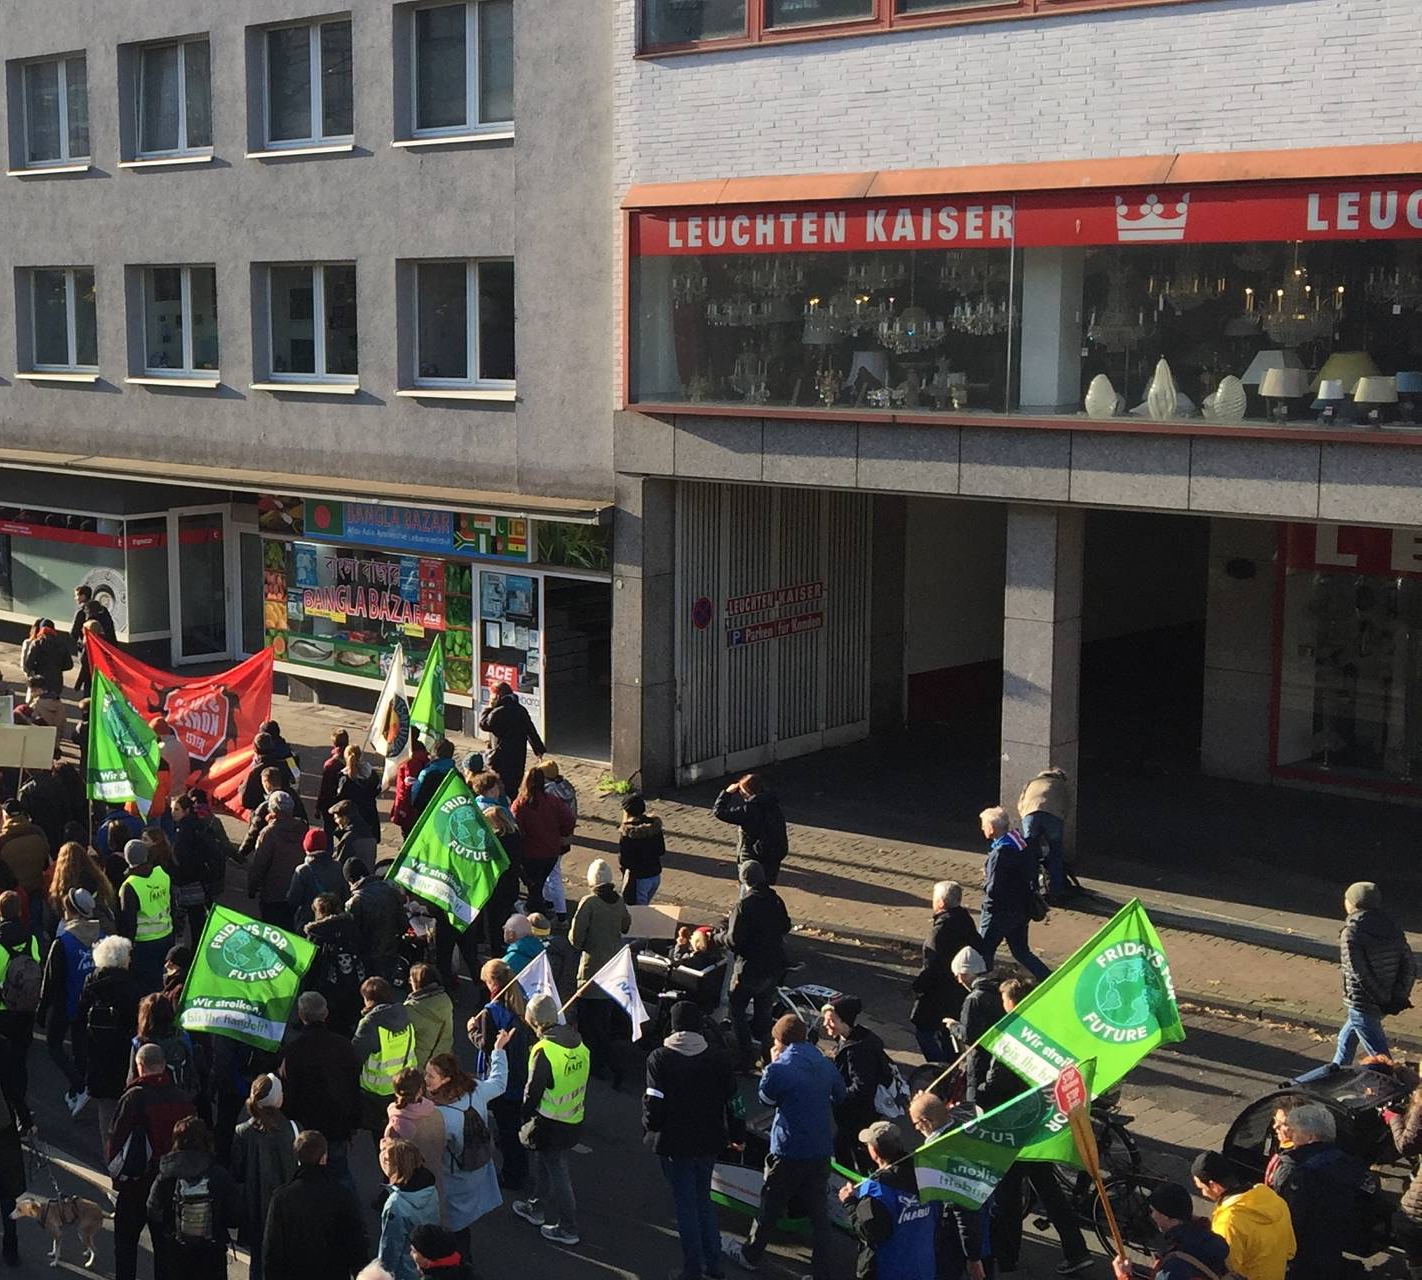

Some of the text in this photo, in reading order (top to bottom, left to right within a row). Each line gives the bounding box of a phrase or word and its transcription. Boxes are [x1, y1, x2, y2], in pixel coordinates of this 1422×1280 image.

[668, 205, 1014, 248] LEUCHTEN KAISER
[346, 503, 451, 533] BANGLA BAZAR
[303, 584, 368, 618] BANGLA
[729, 583, 822, 615] LEUCHTEN KAISER
[423, 612, 441, 624] ACE
[732, 630, 741, 646] P
[745, 625, 774, 643] Parken
[485, 664, 513, 682] ACE
[263, 926, 289, 951] FOR
[1096, 942, 1165, 969] FRIDAYS
[228, 962, 287, 982] FUTURE
[192, 997, 213, 1007] Wir
[1019, 1026, 1043, 1049] Wir
[1082, 1011, 1149, 1043] FUTURE
[902, 1206, 930, 1222] NABU
